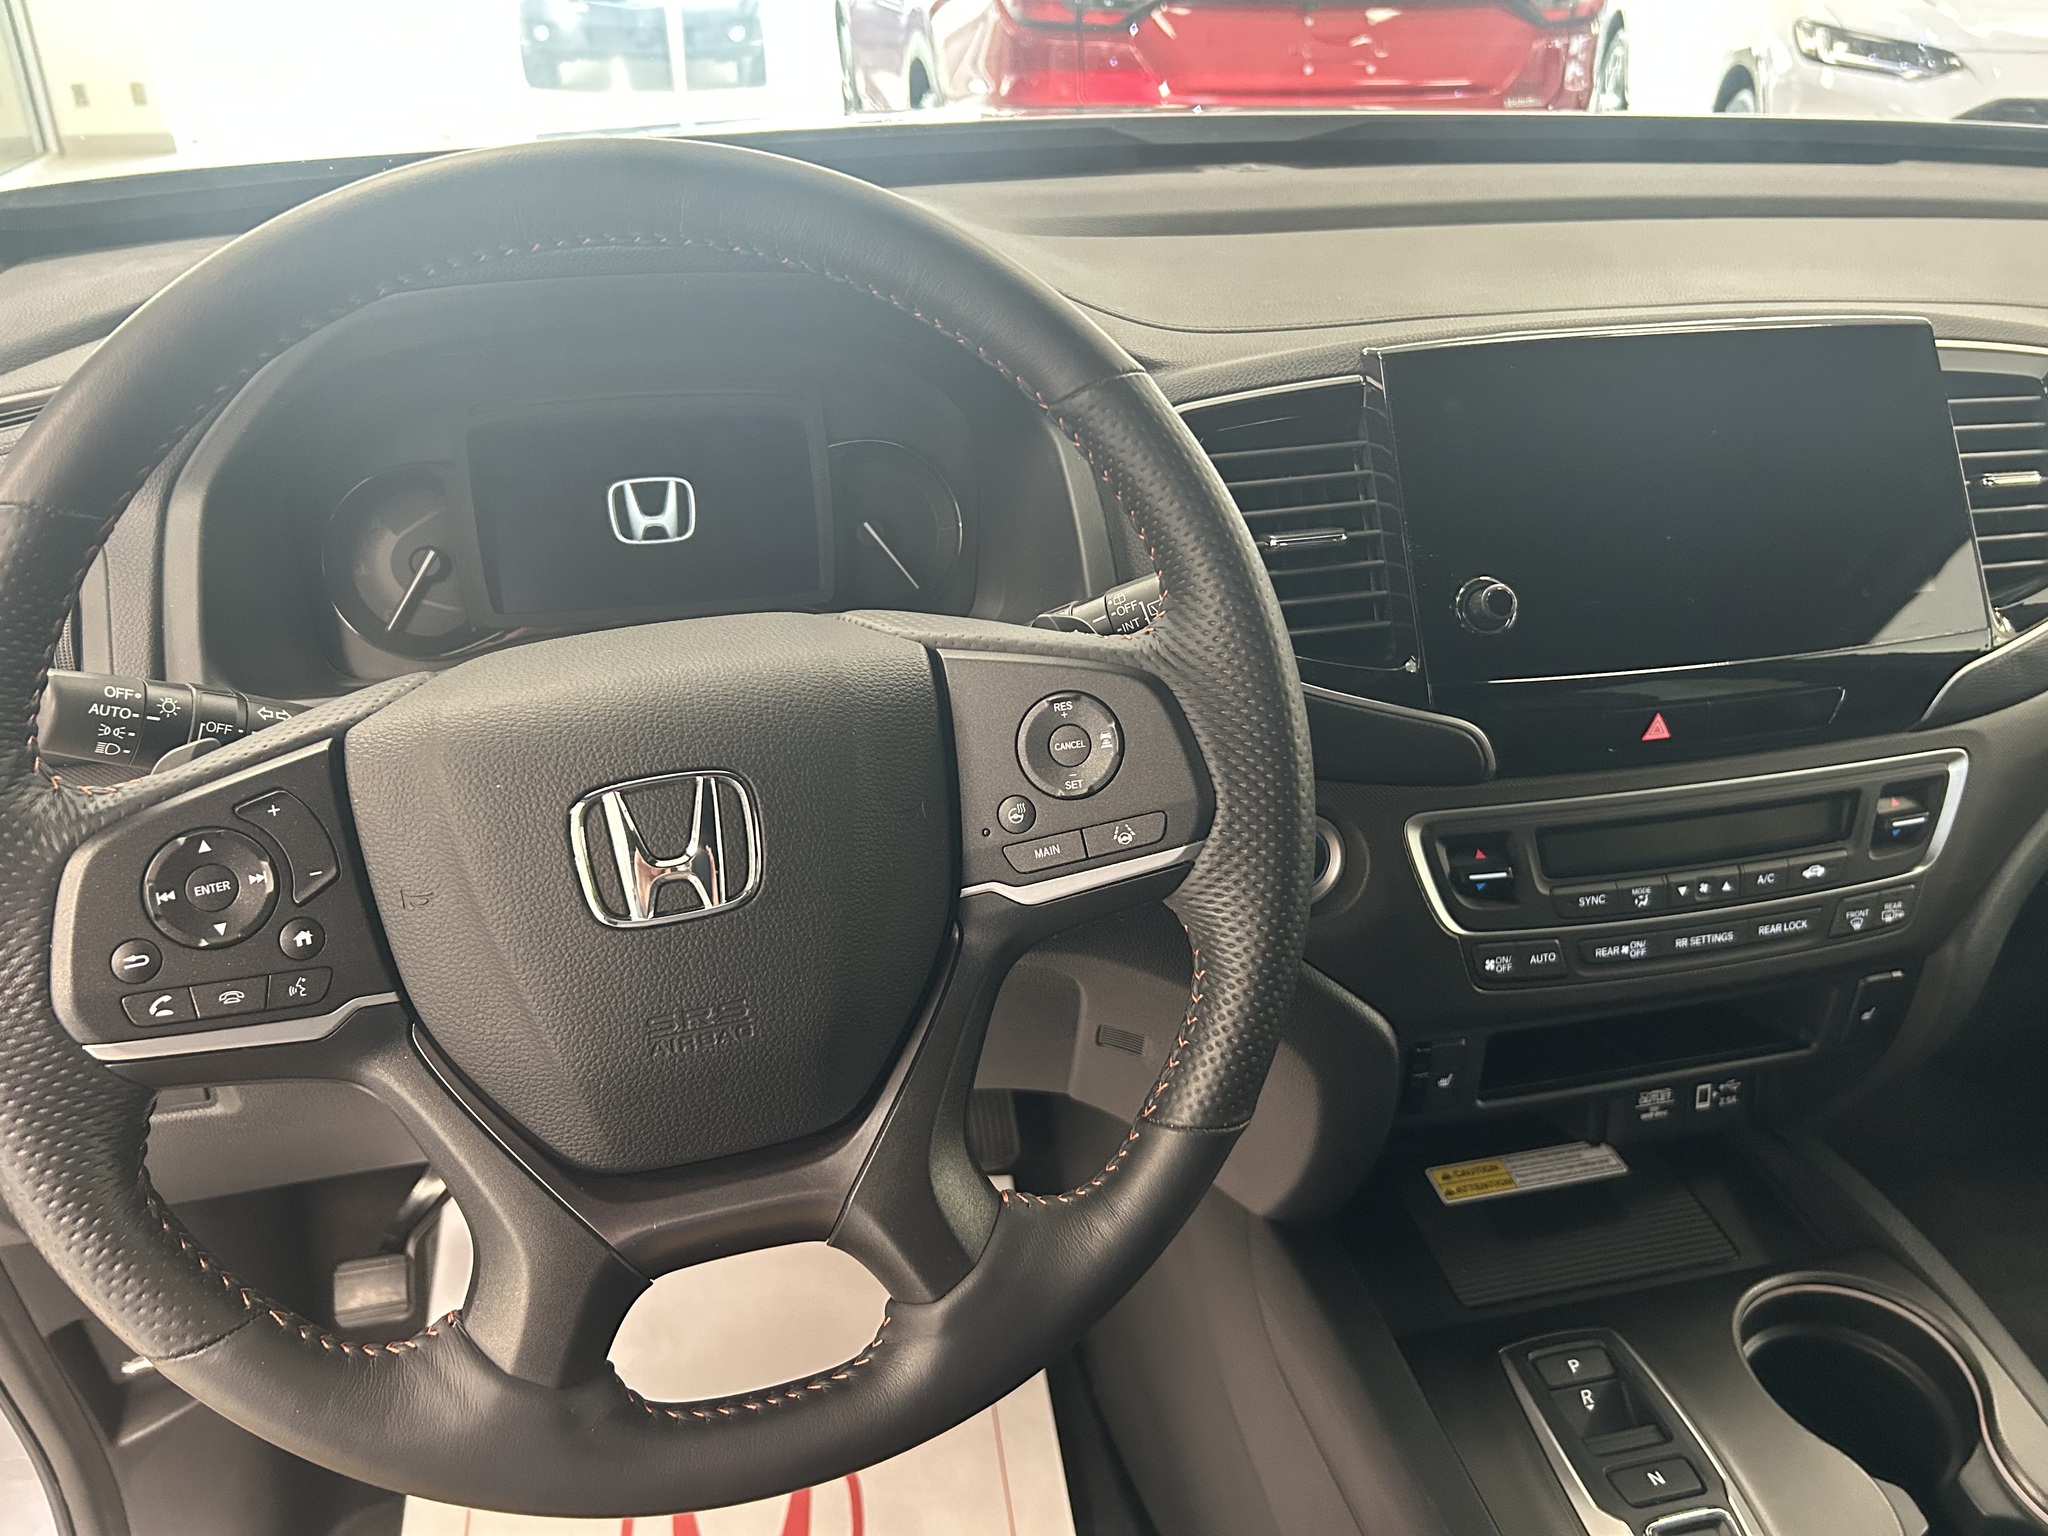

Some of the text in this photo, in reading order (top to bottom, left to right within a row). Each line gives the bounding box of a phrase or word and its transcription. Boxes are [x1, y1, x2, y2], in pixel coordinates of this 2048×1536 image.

[1116, 600, 1138, 617] OFF
[1121, 617, 1141, 633] INT
[104, 685, 134, 700] OFF
[88, 703, 132, 720] AUTO
[1053, 701, 1073, 713] RES
[205, 721, 234, 735] OFF
[1054, 739, 1086, 752] CANCEL
[1064, 779, 1084, 791] SET
[1034, 844, 1061, 859] MAIN
[1757, 872, 1775, 885] A/C
[193, 880, 231, 896] ENTER
[1578, 893, 1606, 908] SYNC
[1884, 901, 1903, 910] REAR
[1846, 908, 1870, 919] FRONT
[1758, 919, 1808, 936] REAR LOCK
[1675, 930, 1734, 948] RR SETTINGS
[1595, 939, 1647, 959] REAR ON/
[1629, 948, 1647, 959] OFF
[1495, 954, 1513, 965] ON/
[1529, 951, 1556, 965] AUTO
[1495, 963, 1513, 974] OFF
[1567, 1358, 1580, 1374] P
[1580, 1389, 1594, 1406] R
[1647, 1471, 1667, 1486] N
